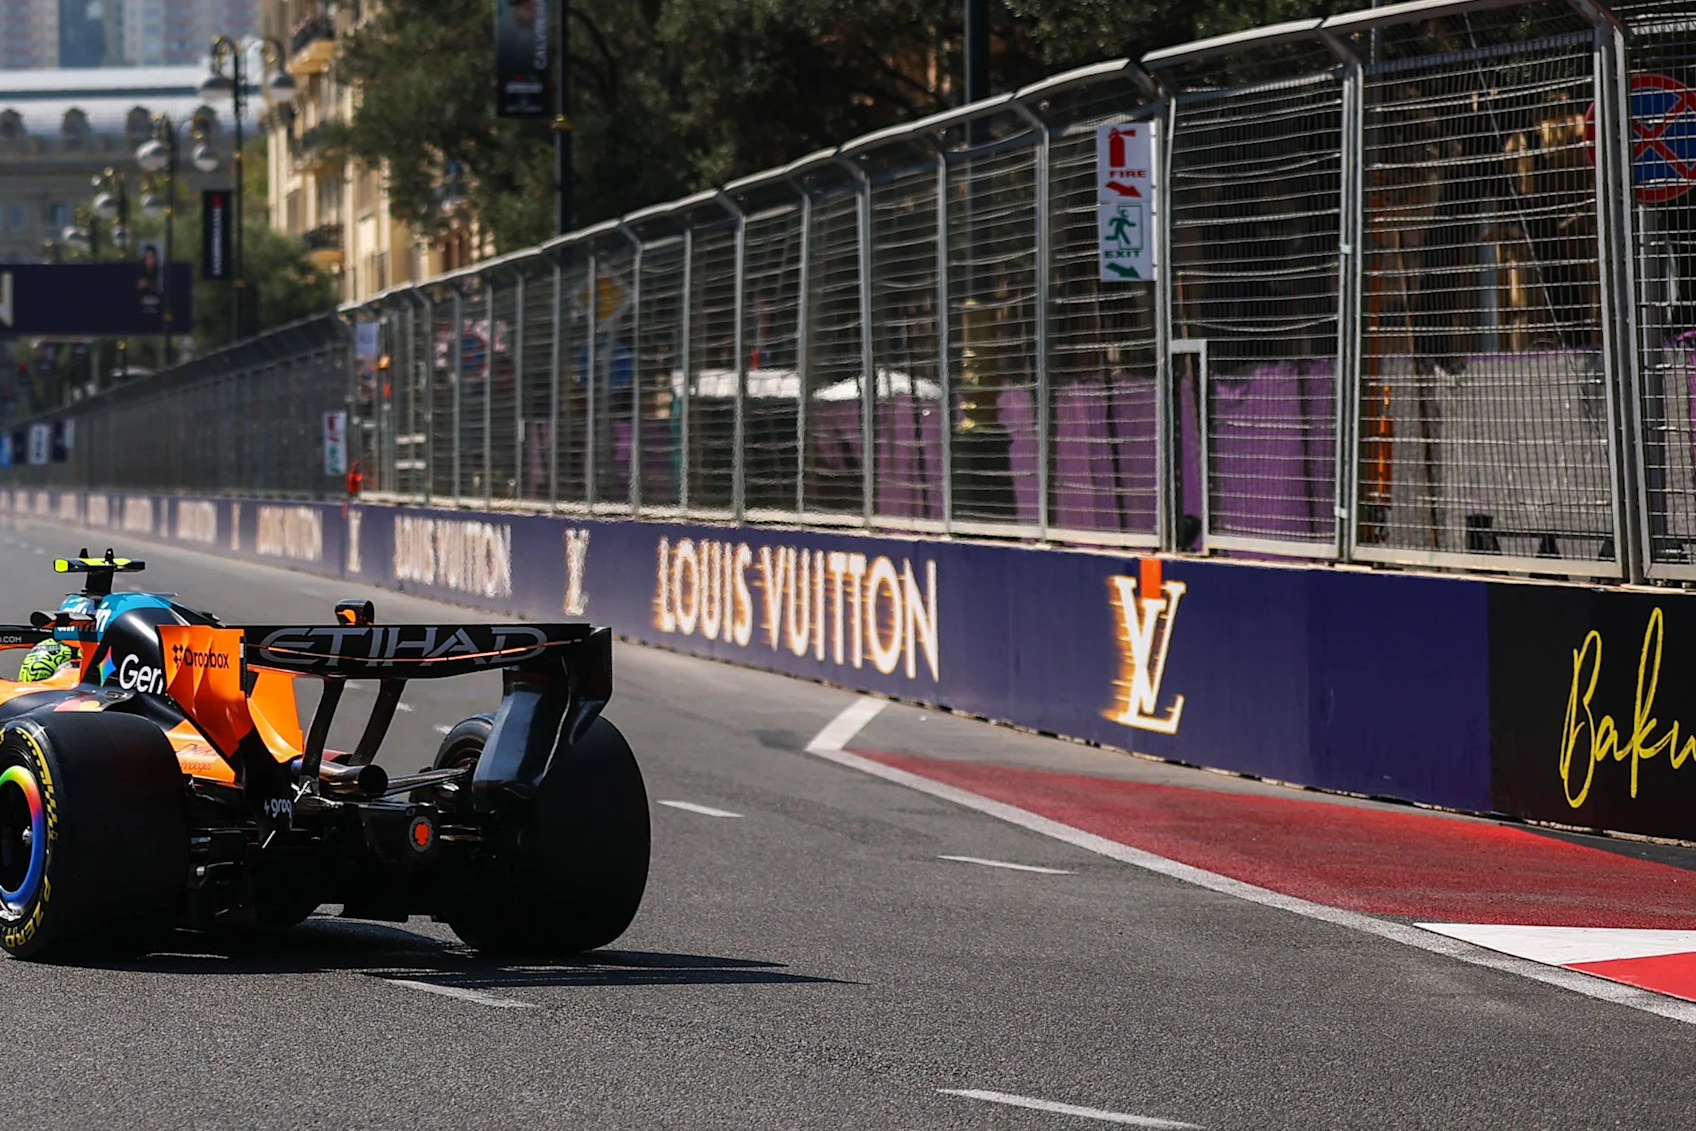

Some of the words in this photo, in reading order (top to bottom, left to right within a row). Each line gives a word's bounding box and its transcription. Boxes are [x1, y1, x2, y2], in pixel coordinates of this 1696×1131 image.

[1109, 170, 1147, 179] FIRE
[1104, 250, 1142, 259] EXIT
[657, 535, 753, 647] LOUIS
[760, 544, 939, 683] VUITTON
[258, 626, 549, 667] ETIHAD
